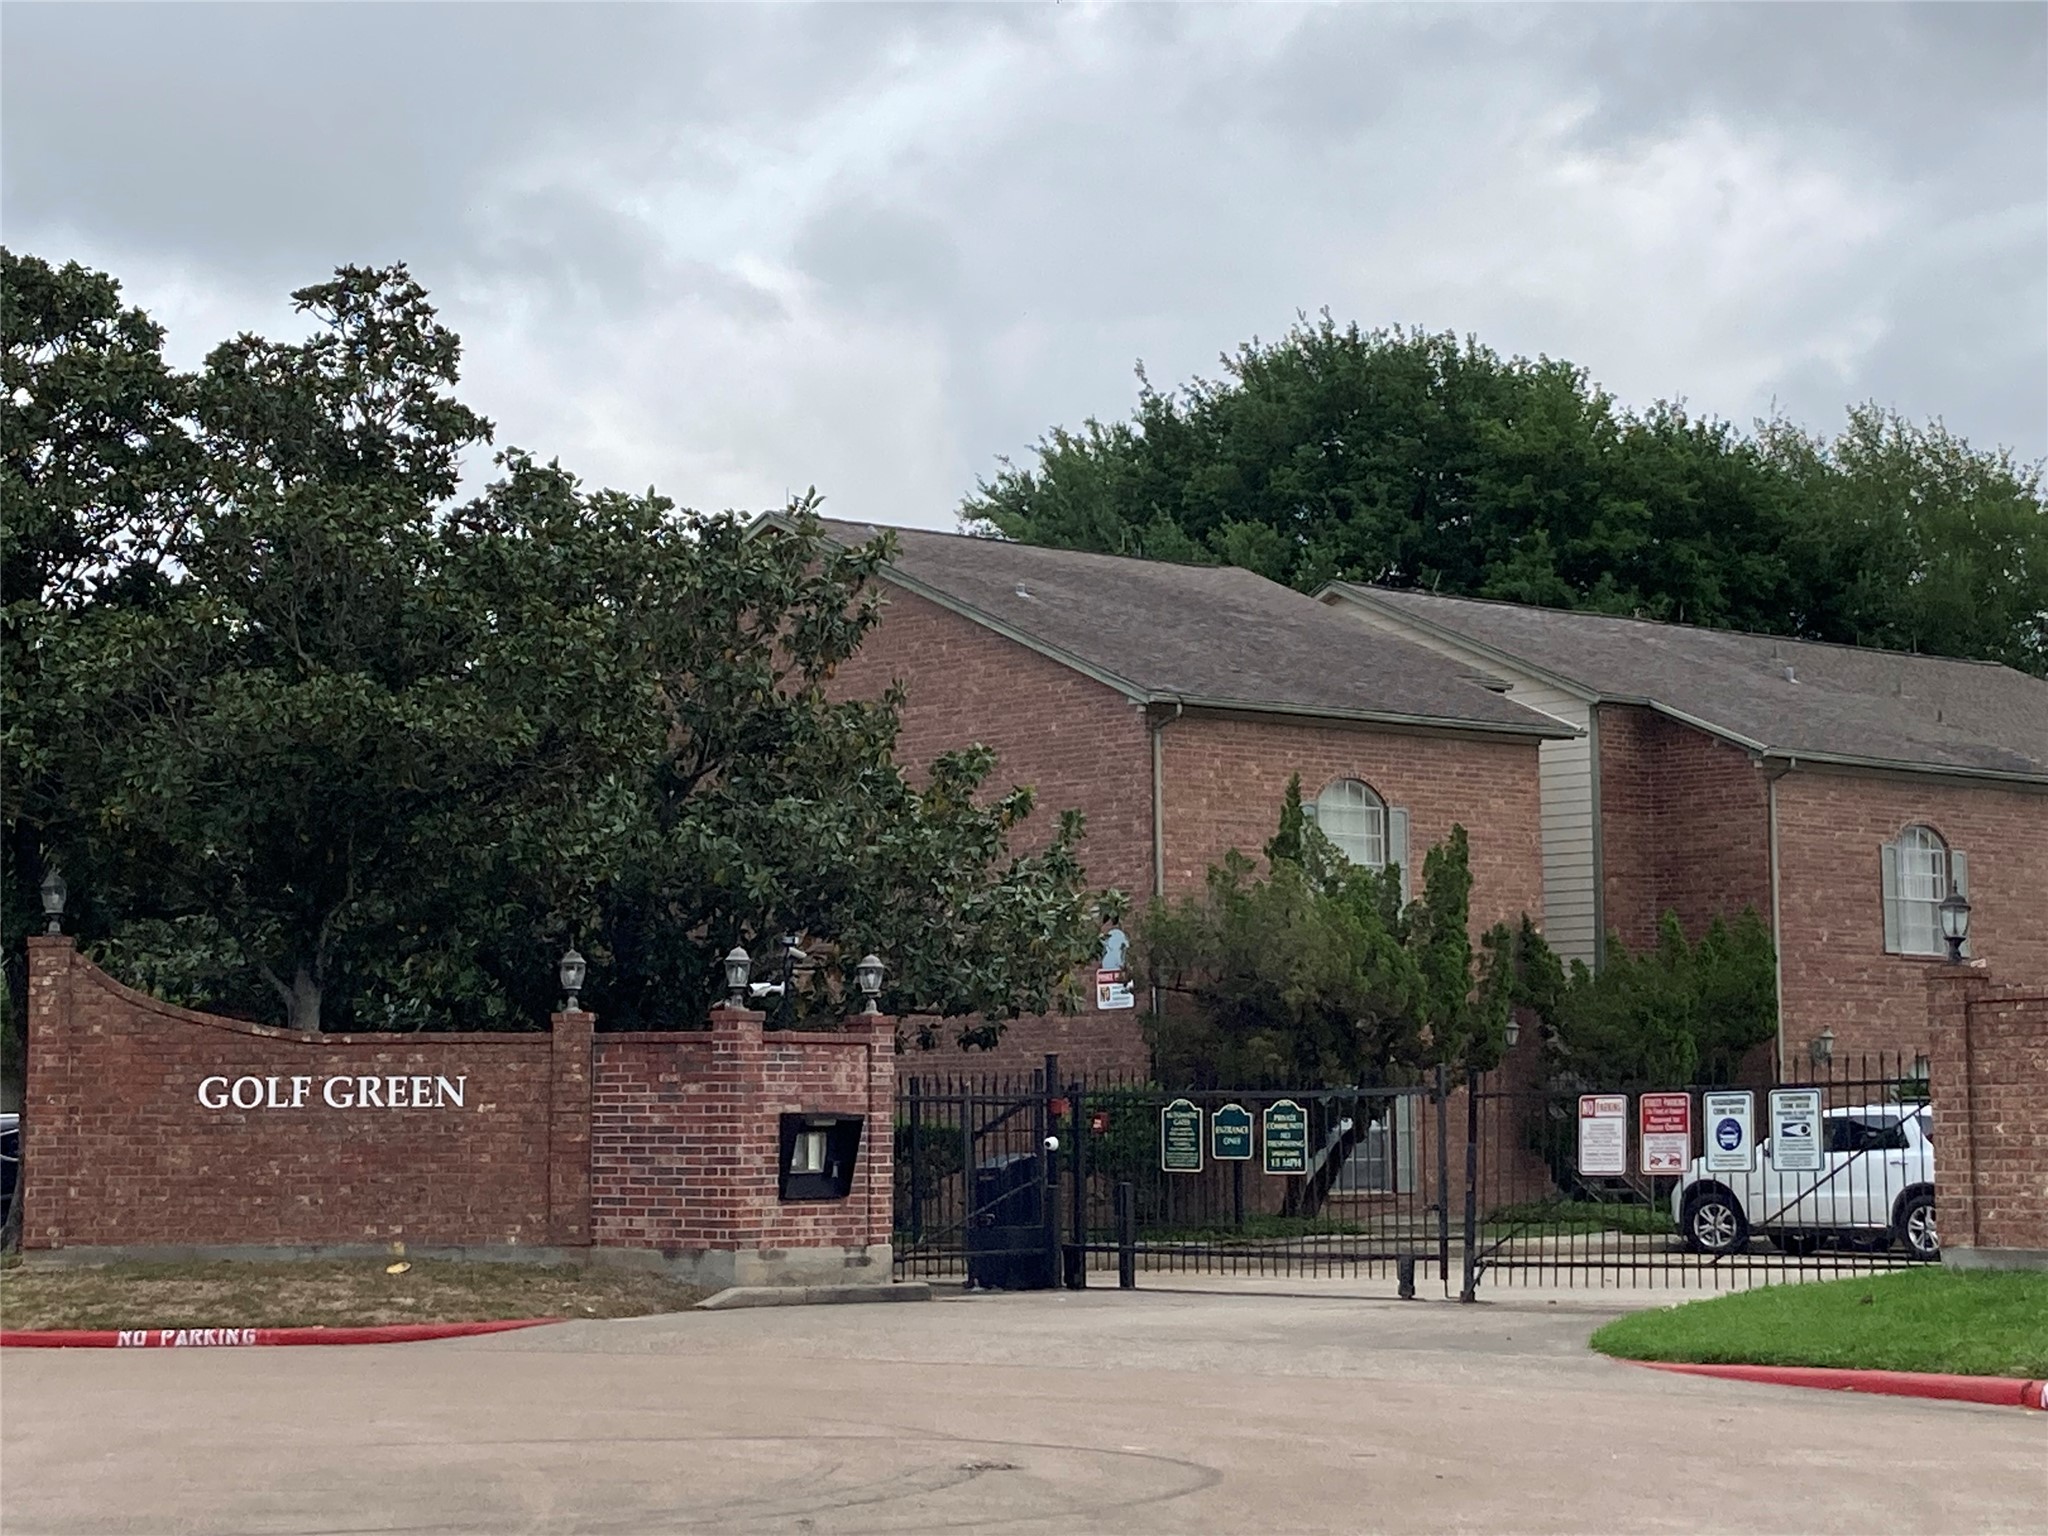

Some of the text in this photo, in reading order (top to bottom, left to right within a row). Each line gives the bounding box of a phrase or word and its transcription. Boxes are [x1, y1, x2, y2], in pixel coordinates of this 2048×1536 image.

[198, 1076, 467, 1109] GOLF GREEN
[1582, 1100, 1594, 1115] NO
[1215, 1125, 1249, 1134] ENTRANCE
[1266, 1122, 1304, 1130] COMMUNITY
[1282, 1158, 1301, 1167] MPH
[117, 1328, 257, 1347] NO PARKING
